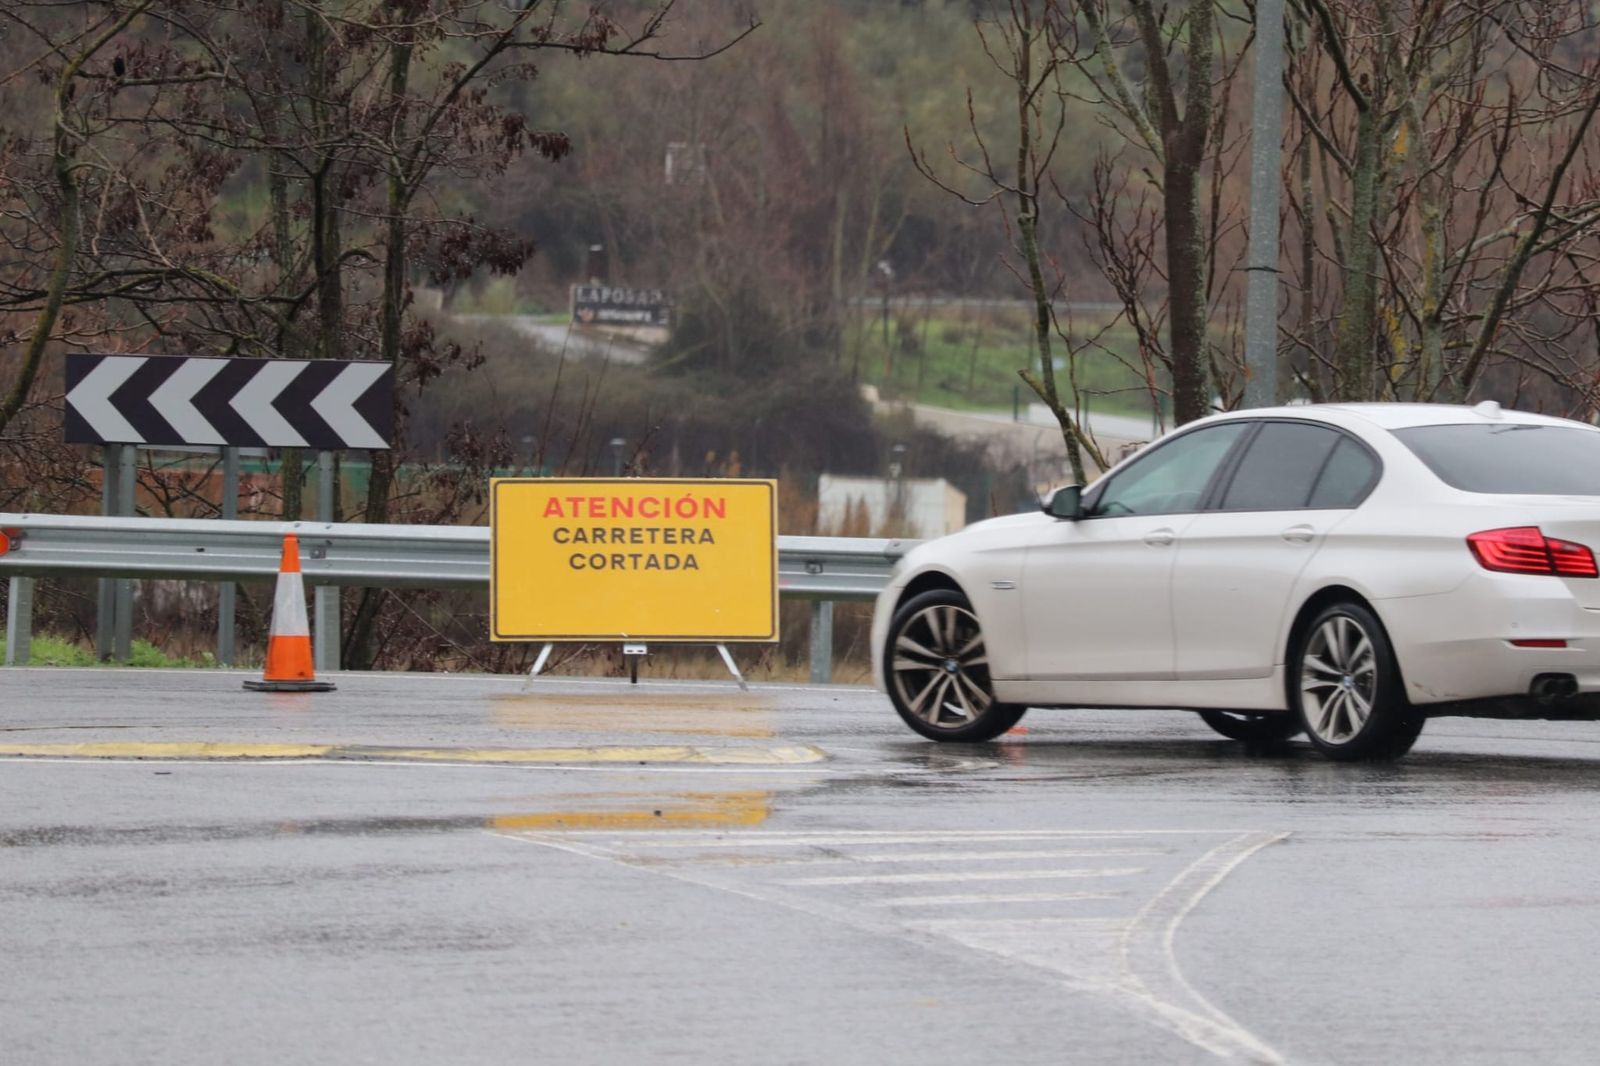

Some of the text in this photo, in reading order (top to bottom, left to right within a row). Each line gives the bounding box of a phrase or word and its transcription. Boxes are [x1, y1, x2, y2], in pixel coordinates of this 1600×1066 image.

[543, 494, 726, 519] ATENCIÓN
[553, 527, 715, 545] CARRETERA
[569, 553, 699, 570] CORTADA
